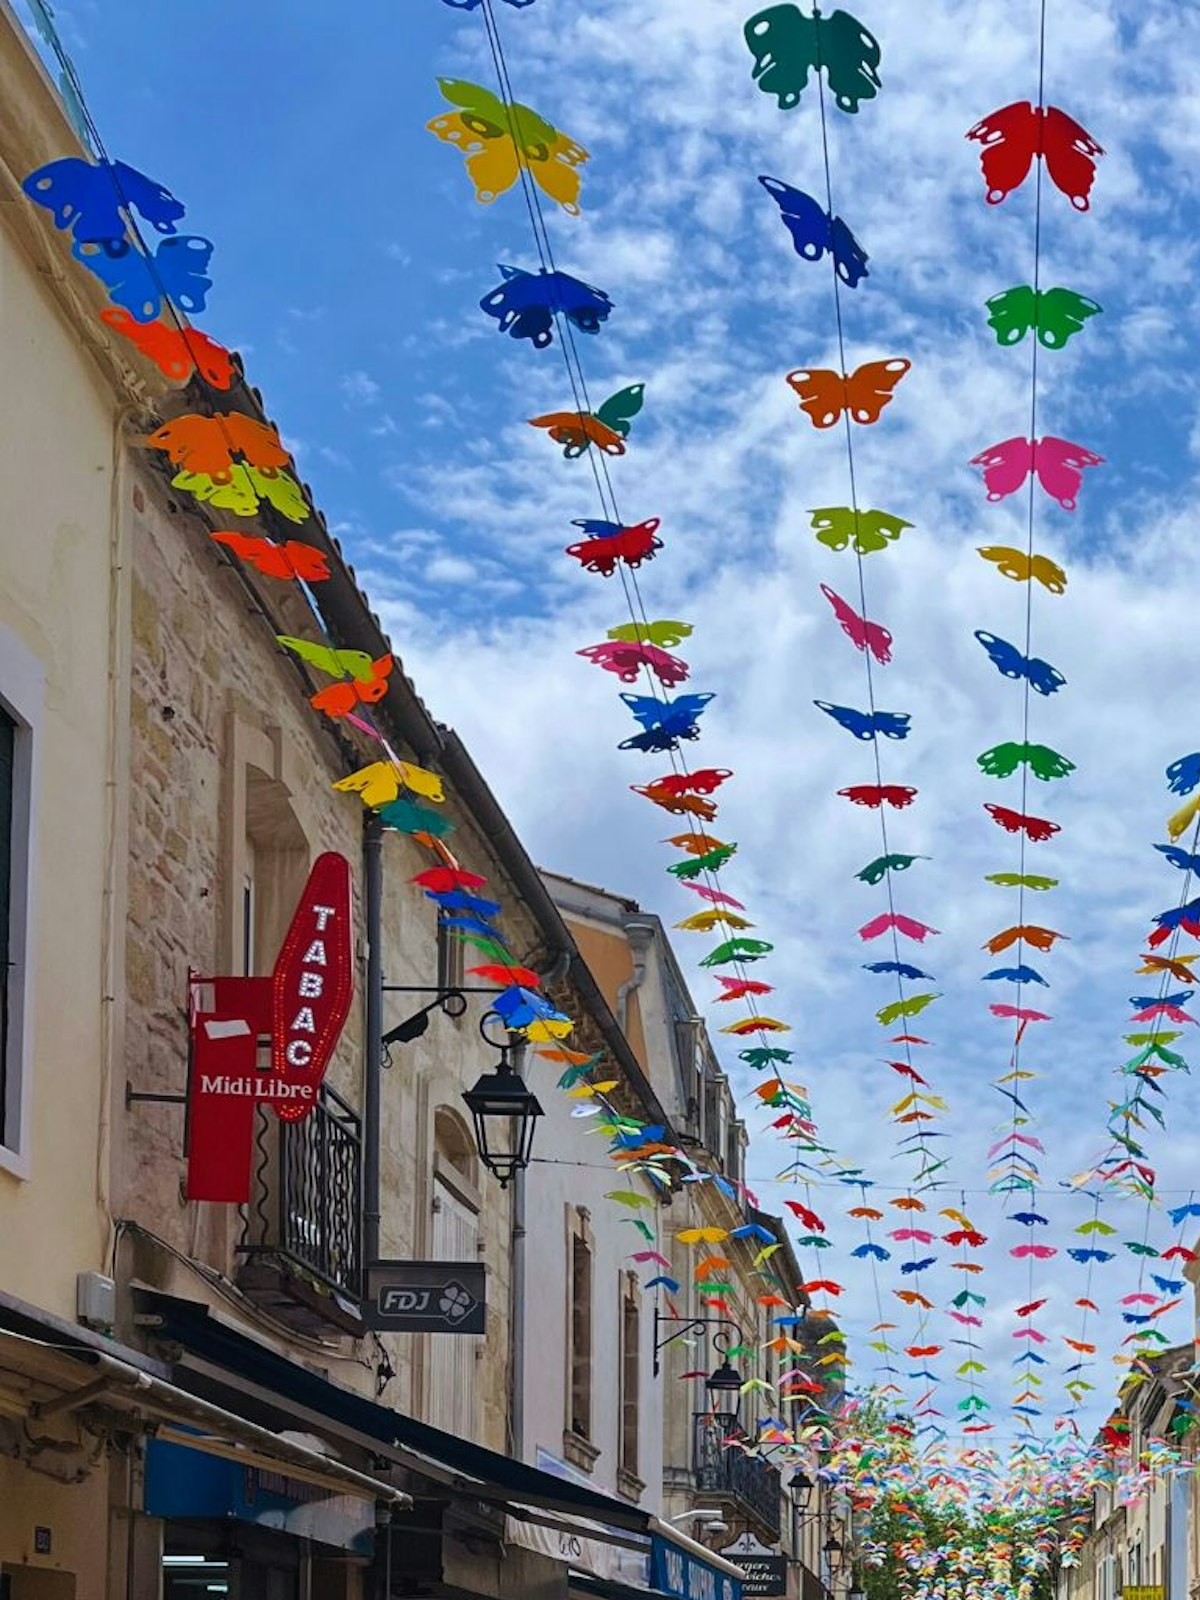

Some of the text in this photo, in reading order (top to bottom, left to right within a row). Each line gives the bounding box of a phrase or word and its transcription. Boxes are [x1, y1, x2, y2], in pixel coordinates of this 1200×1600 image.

[285, 905, 335, 1066] TABAC
[200, 1074, 313, 1099] Midi Libre
[384, 1291, 430, 1310] FDJ
